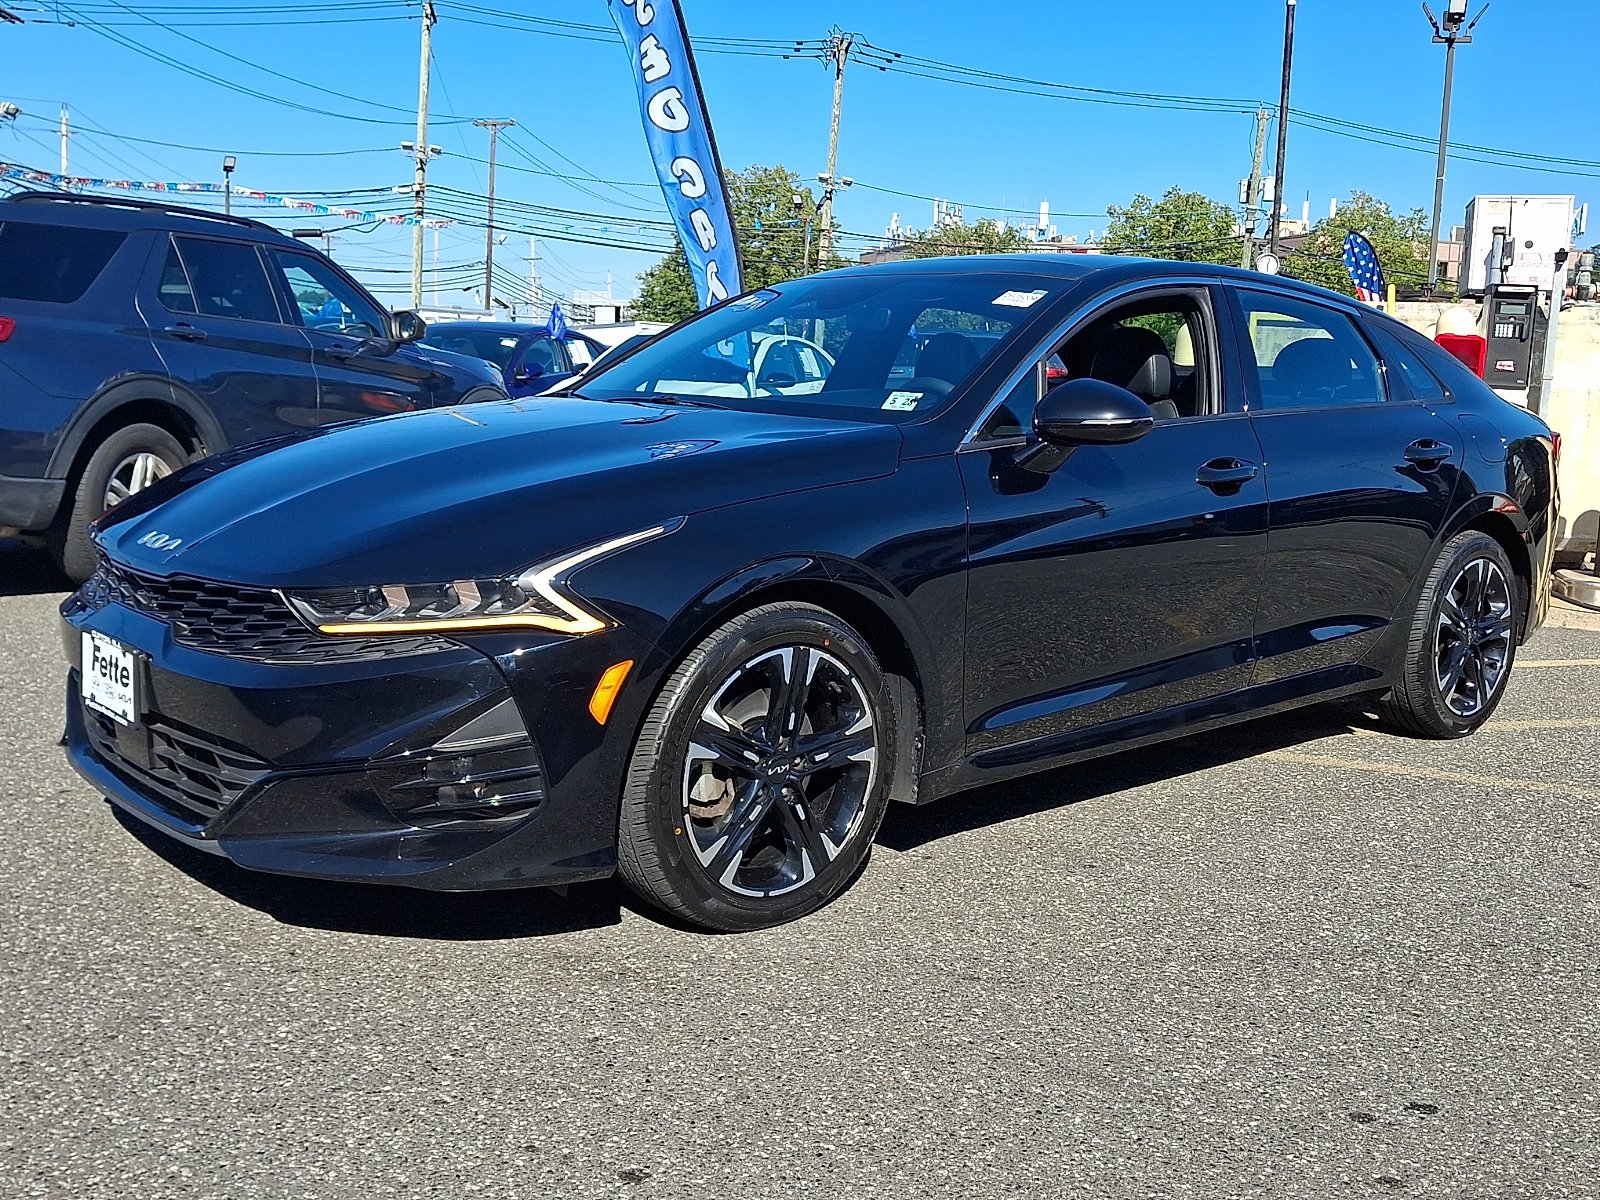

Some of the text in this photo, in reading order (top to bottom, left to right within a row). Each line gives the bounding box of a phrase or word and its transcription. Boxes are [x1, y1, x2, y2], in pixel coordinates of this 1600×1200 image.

[889, 397, 899, 405] 5
[136, 530, 182, 551] KIA
[92, 644, 130, 688] Fette
